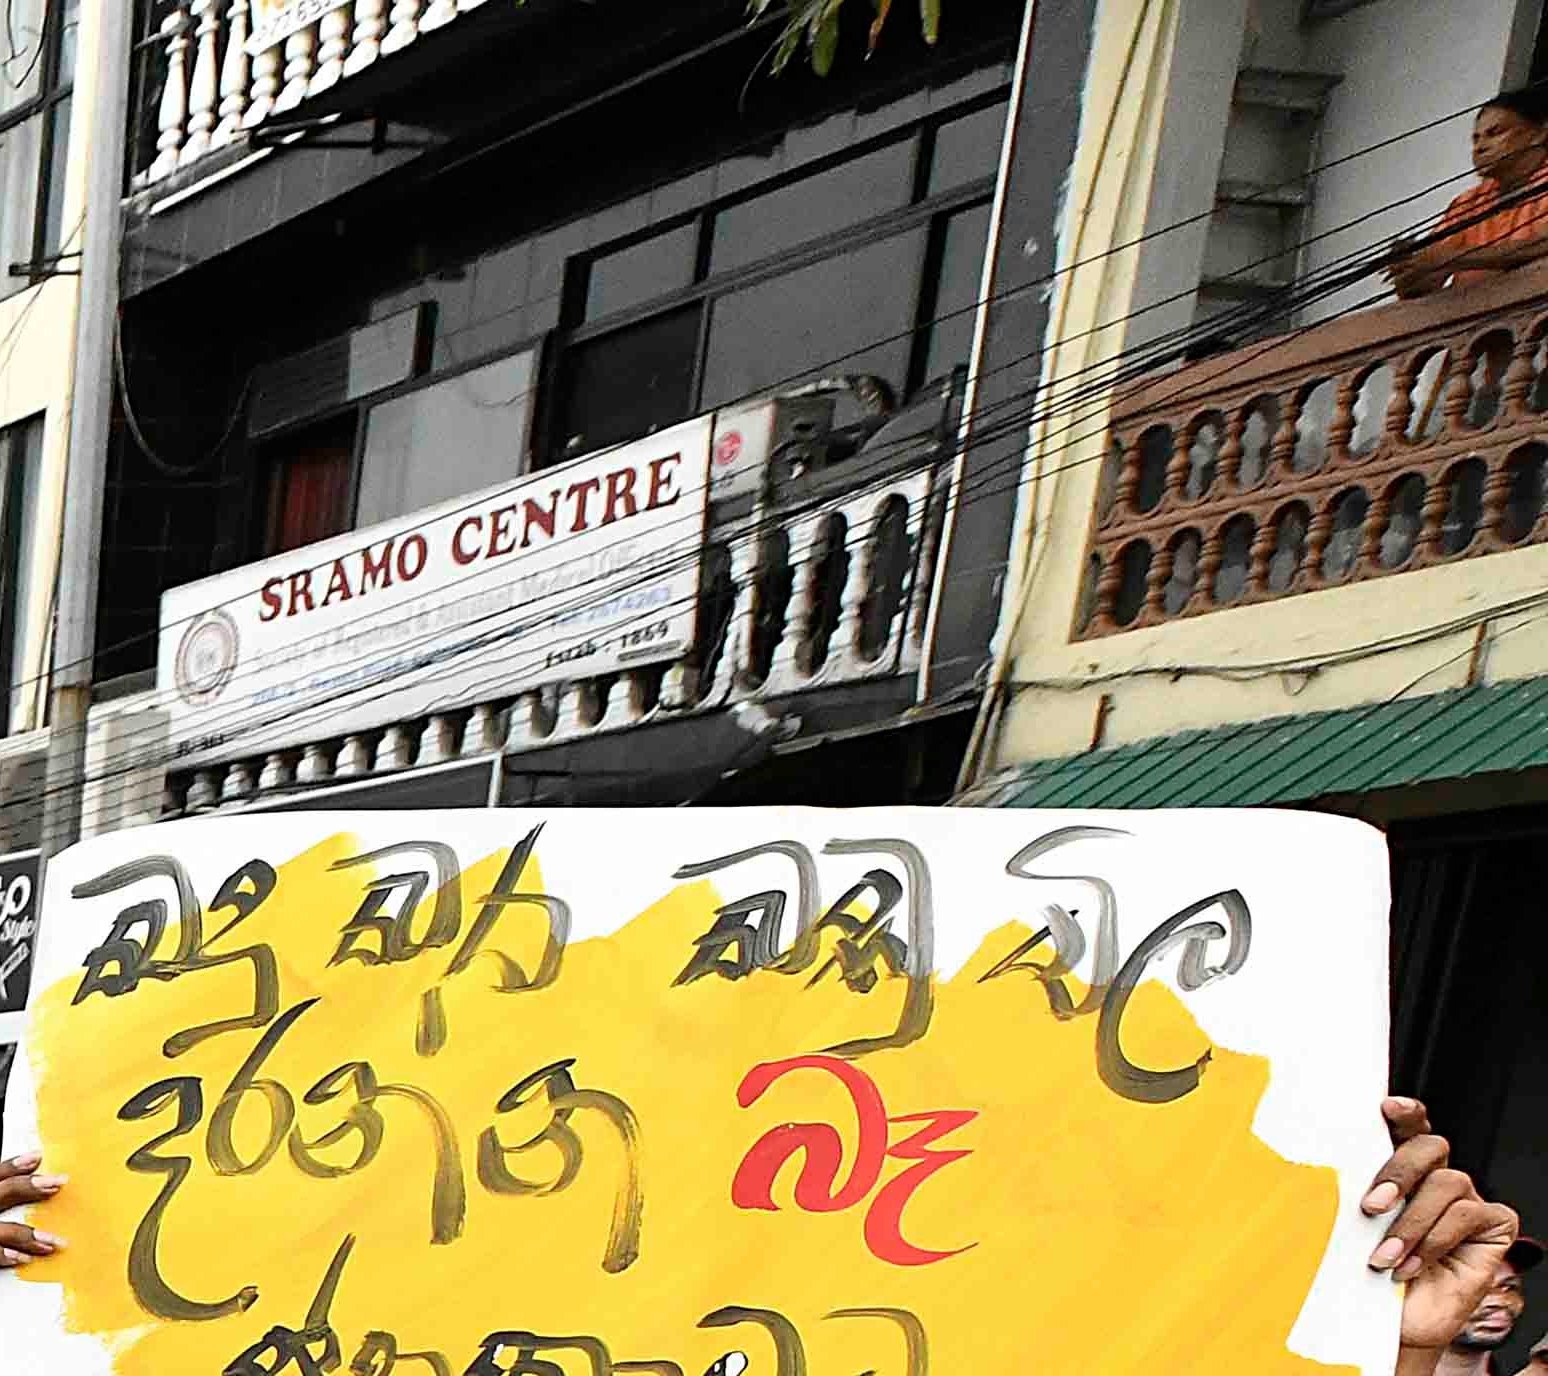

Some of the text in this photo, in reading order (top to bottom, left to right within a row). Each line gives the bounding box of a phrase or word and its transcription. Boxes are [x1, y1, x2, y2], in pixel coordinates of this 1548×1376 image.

[258, 453, 681, 623] SRAMO CENTRE
[71, 854, 279, 1058] බදු
[977, 825, 1252, 1104] මිල
